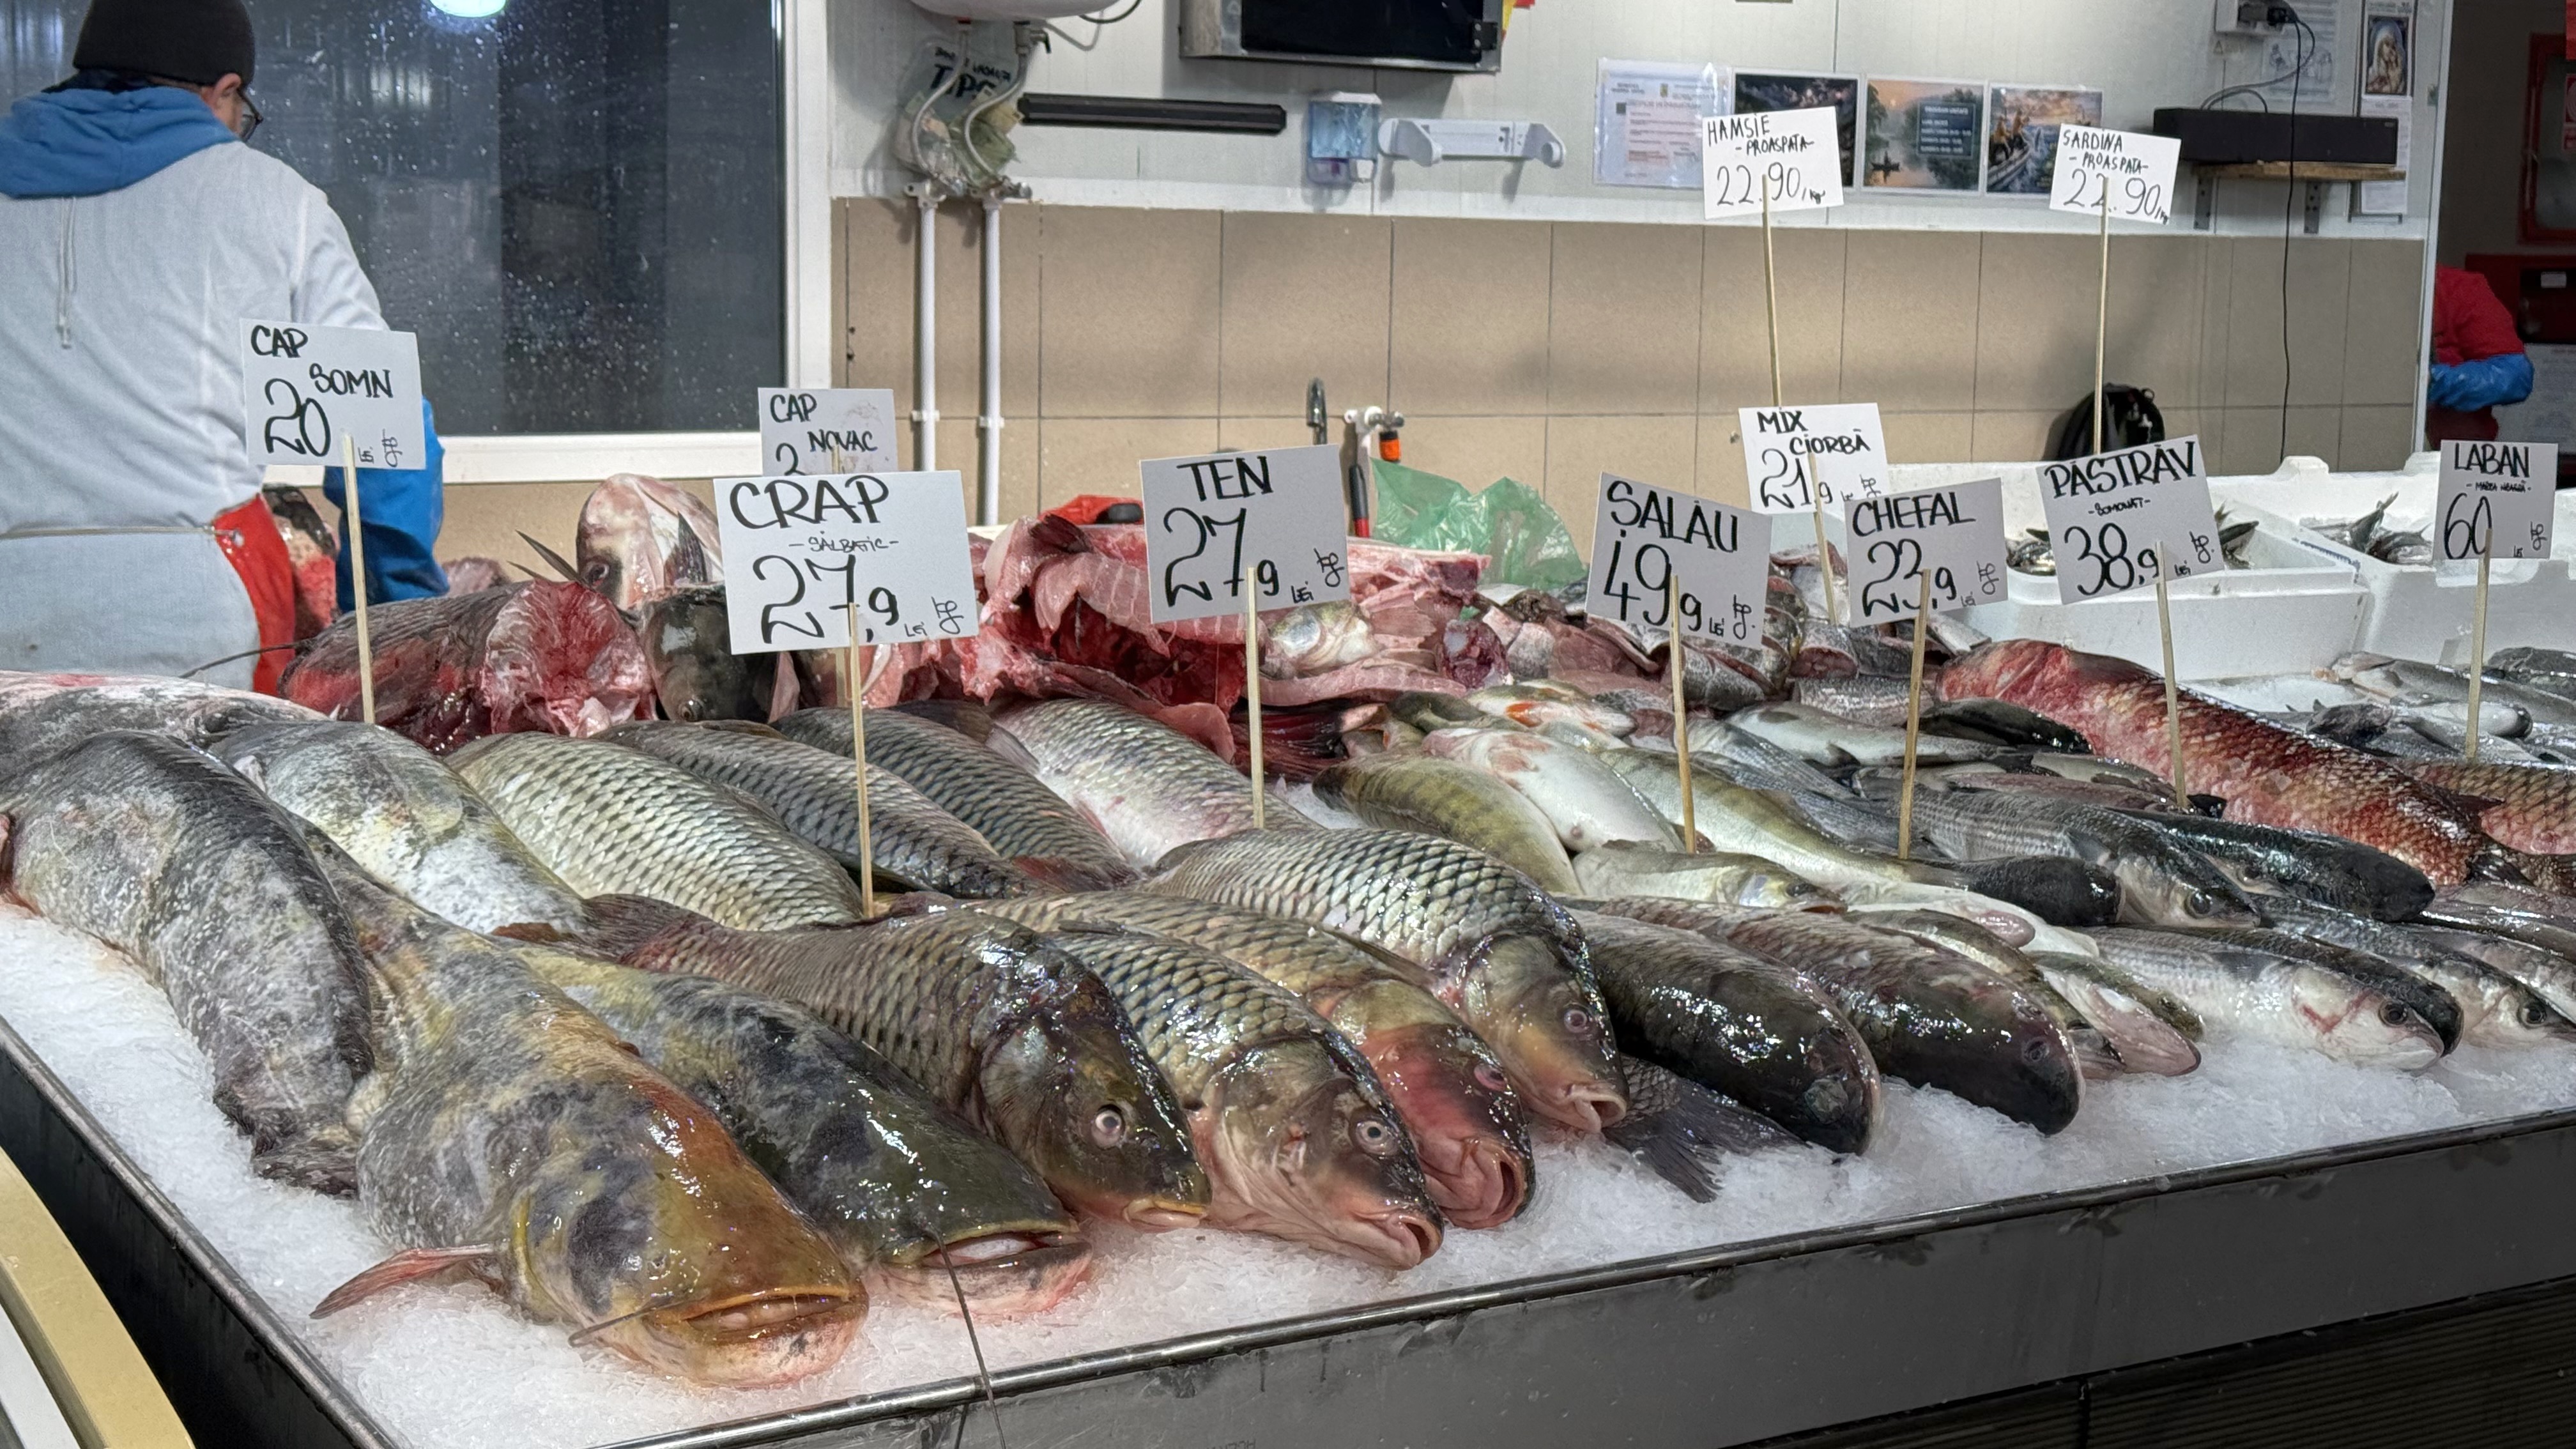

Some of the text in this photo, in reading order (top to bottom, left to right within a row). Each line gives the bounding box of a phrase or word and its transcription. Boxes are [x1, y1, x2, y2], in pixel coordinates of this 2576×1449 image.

[250, 325, 309, 358] CAP
[309, 363, 394, 398] SOMN
[264, 378, 331, 457] 20
[770, 393, 817, 423] CAP
[1756, 410, 1809, 434] MIX
[807, 429, 878, 452] NOVAC
[2454, 443, 2530, 478] LABAN
[1176, 456, 1274, 502] TEN
[730, 475, 889, 529] CRAP
[1852, 491, 1977, 537] CHEFAL
[2444, 493, 2493, 560] 60
